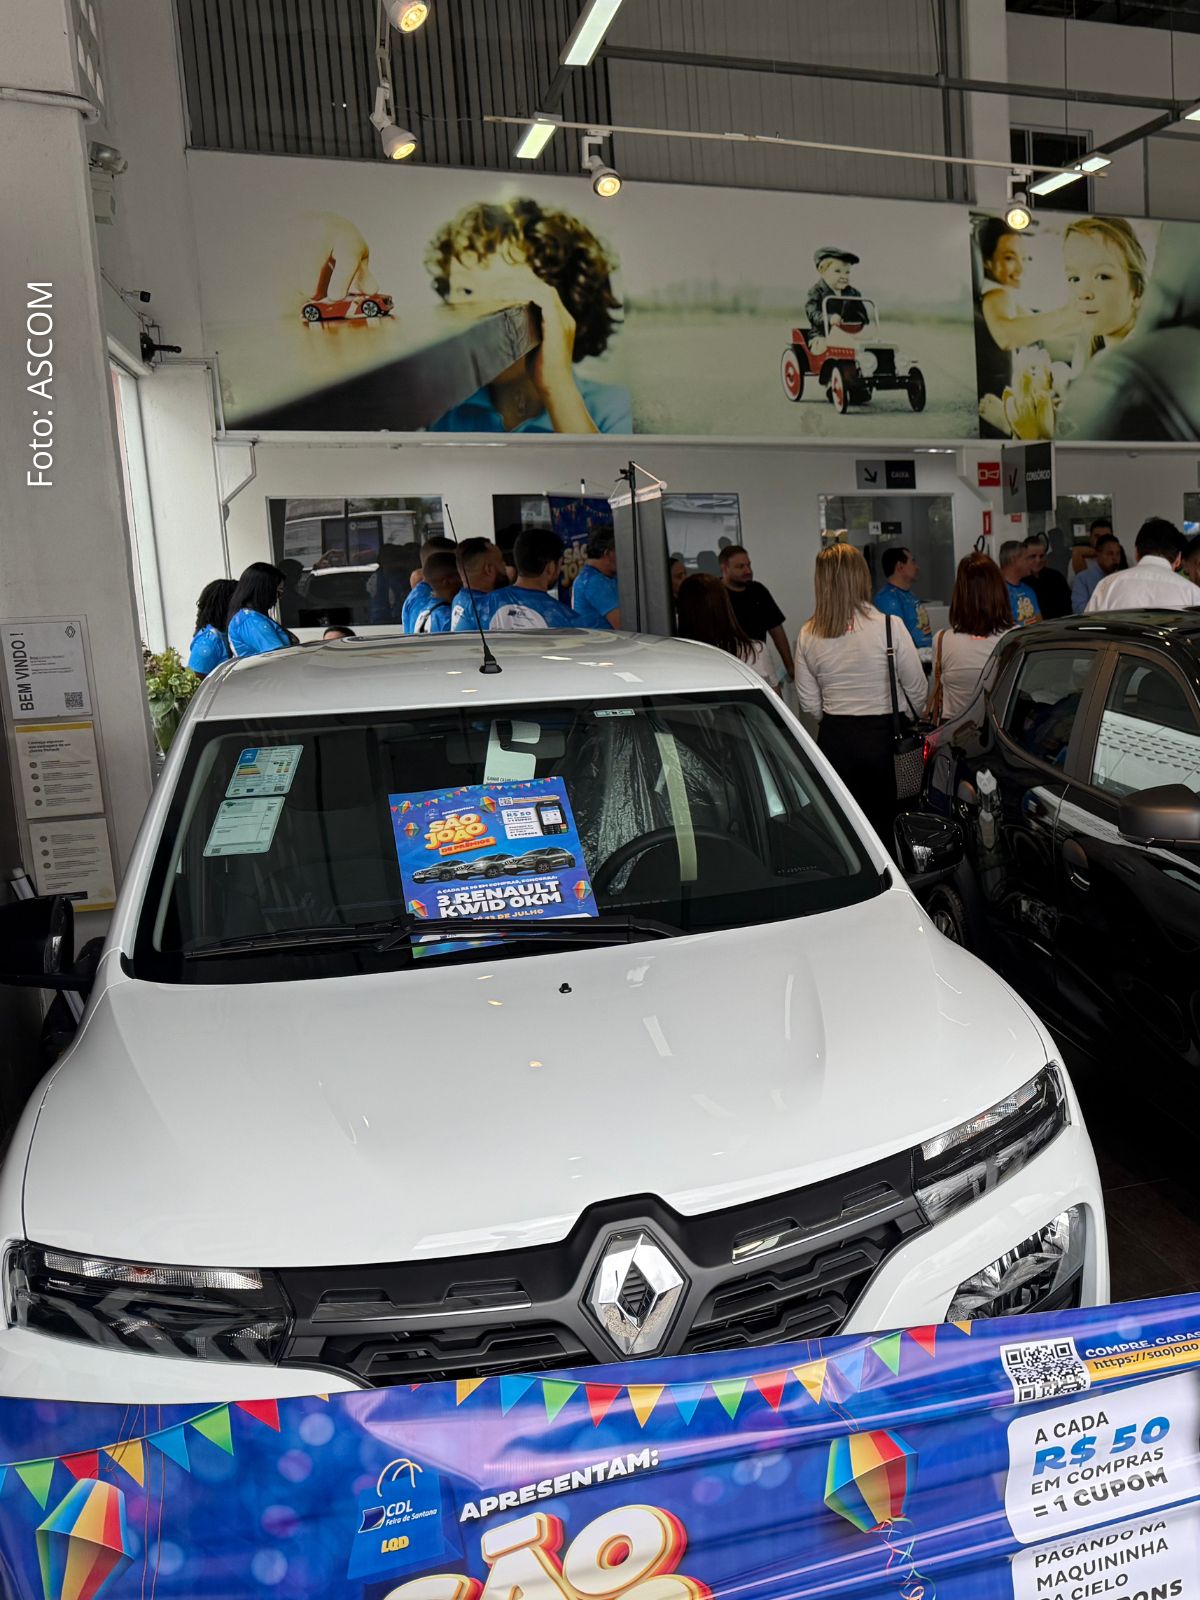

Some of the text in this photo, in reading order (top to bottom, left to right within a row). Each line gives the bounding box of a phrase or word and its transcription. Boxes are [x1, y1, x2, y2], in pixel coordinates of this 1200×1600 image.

[11, 640, 30, 680] VINDO
[17, 683, 35, 711] BEM
[424, 822, 488, 850] JOÃO
[429, 813, 482, 832] SÃO
[436, 881, 560, 907] 3 RENAULT
[440, 899, 506, 918] KWID
[512, 909, 544, 917] JULHO
[1085, 1338, 1155, 1358] COMPRE,
[1034, 1411, 1110, 1445] A CADA
[1032, 1416, 1171, 1477] R$ 50
[459, 1447, 659, 1523] APRESENTAM:
[1031, 1447, 1164, 1496] EM COMPRAS
[1053, 1494, 1068, 1512] 1
[1073, 1466, 1169, 1507] CUPOM
[385, 1508, 438, 1527] Feira de Santana
[386, 1499, 413, 1517] CDL
[383, 1504, 688, 1600] ÃO
[1034, 1520, 1167, 1569] PAGANDO NA
[1036, 1537, 1169, 1592] MAQUININHA
[1071, 1573, 1129, 1600] CIELO
